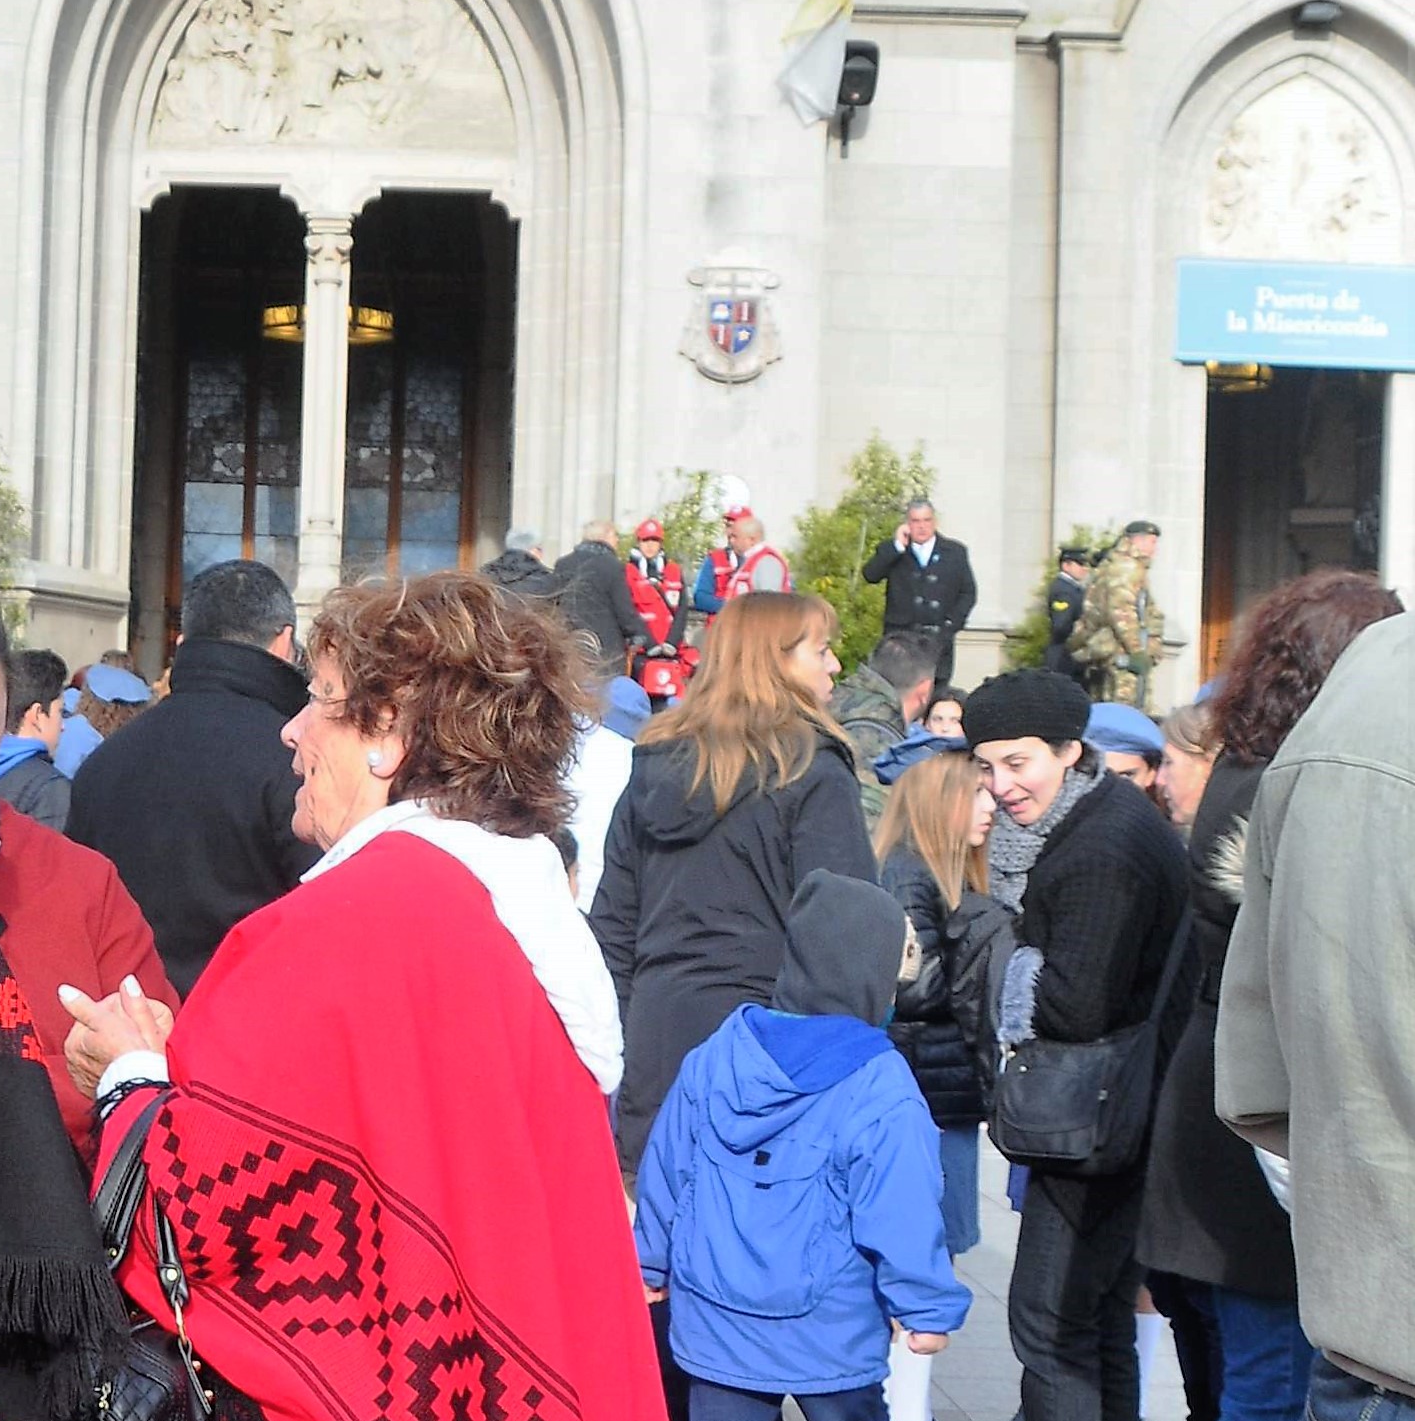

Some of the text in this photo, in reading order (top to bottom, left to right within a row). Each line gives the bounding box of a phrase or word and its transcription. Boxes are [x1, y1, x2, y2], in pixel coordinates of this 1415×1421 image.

[1256, 285, 1361, 312] Puerta de
[1226, 309, 1248, 332] la
